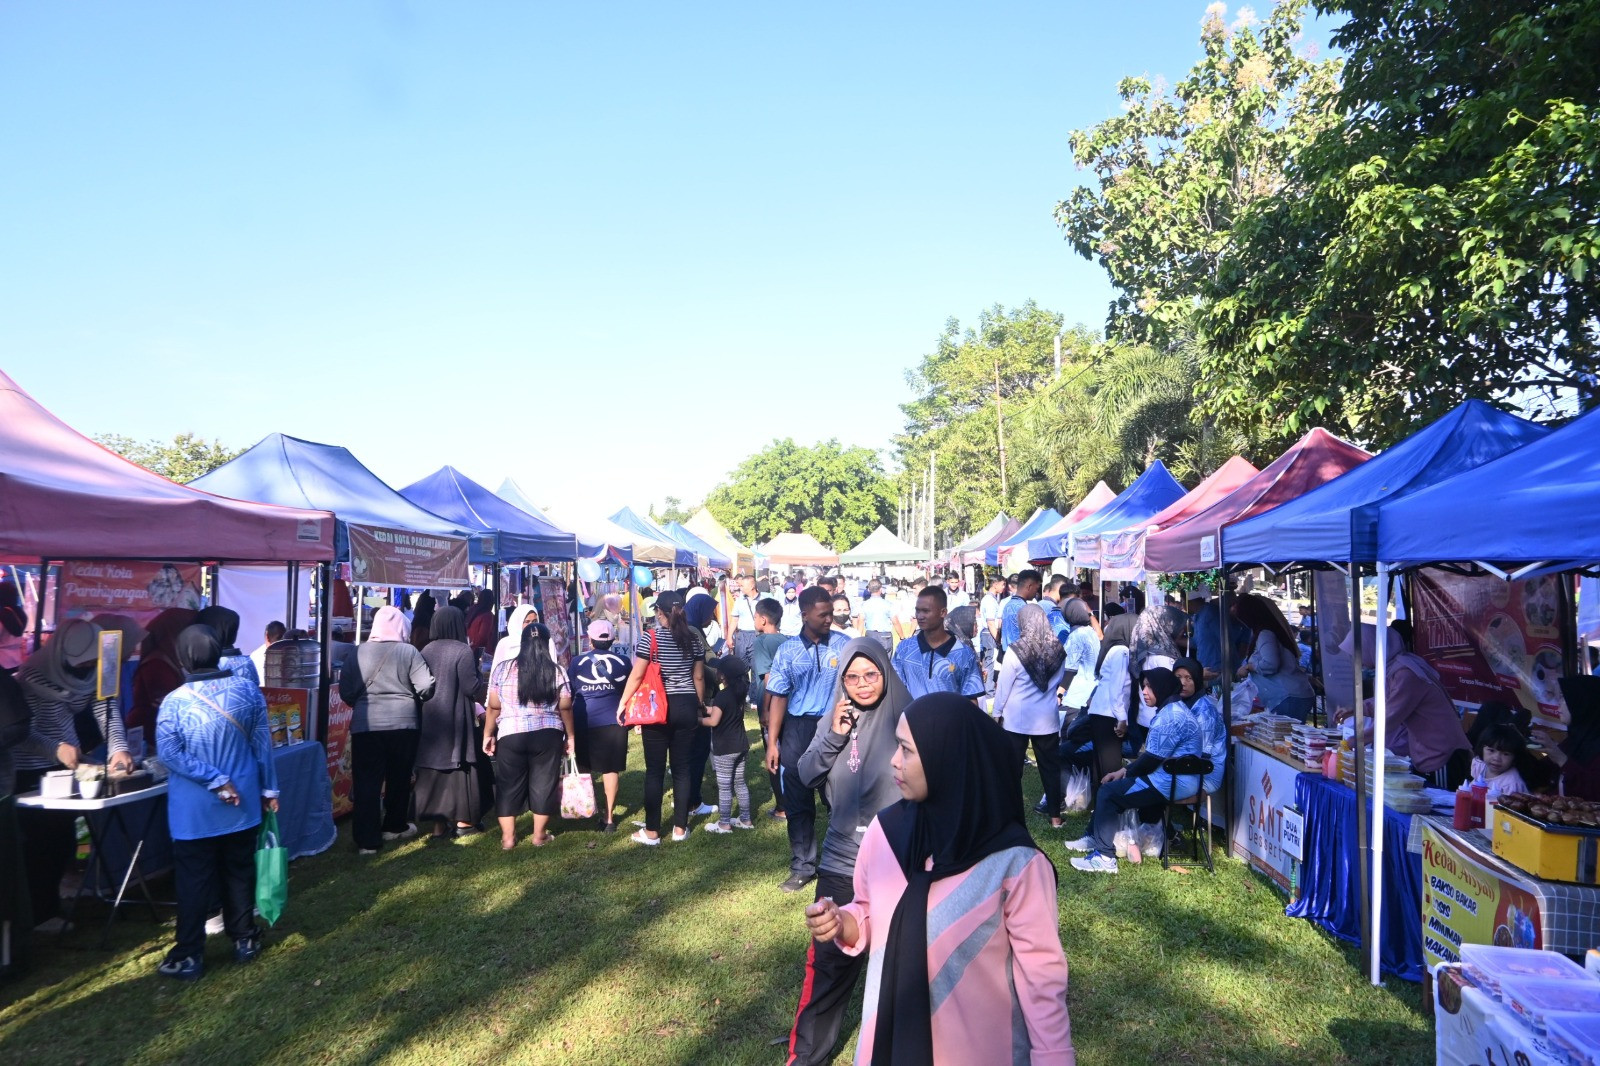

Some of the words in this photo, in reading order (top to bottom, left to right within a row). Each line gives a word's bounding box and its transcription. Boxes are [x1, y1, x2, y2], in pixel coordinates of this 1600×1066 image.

[69, 561, 104, 578] Kedai
[106, 564, 134, 579] Kota
[64, 582, 149, 603] Parahiyangan
[1283, 829, 1300, 847] PUTRI
[1285, 820, 1298, 834] DUA
[1248, 824, 1282, 862] Dessert
[1422, 839, 1457, 876] Kedai
[1430, 875, 1455, 898] BAKSO
[1455, 889, 1477, 915] BAKAR
[1428, 916, 1462, 947] MINUMAN
